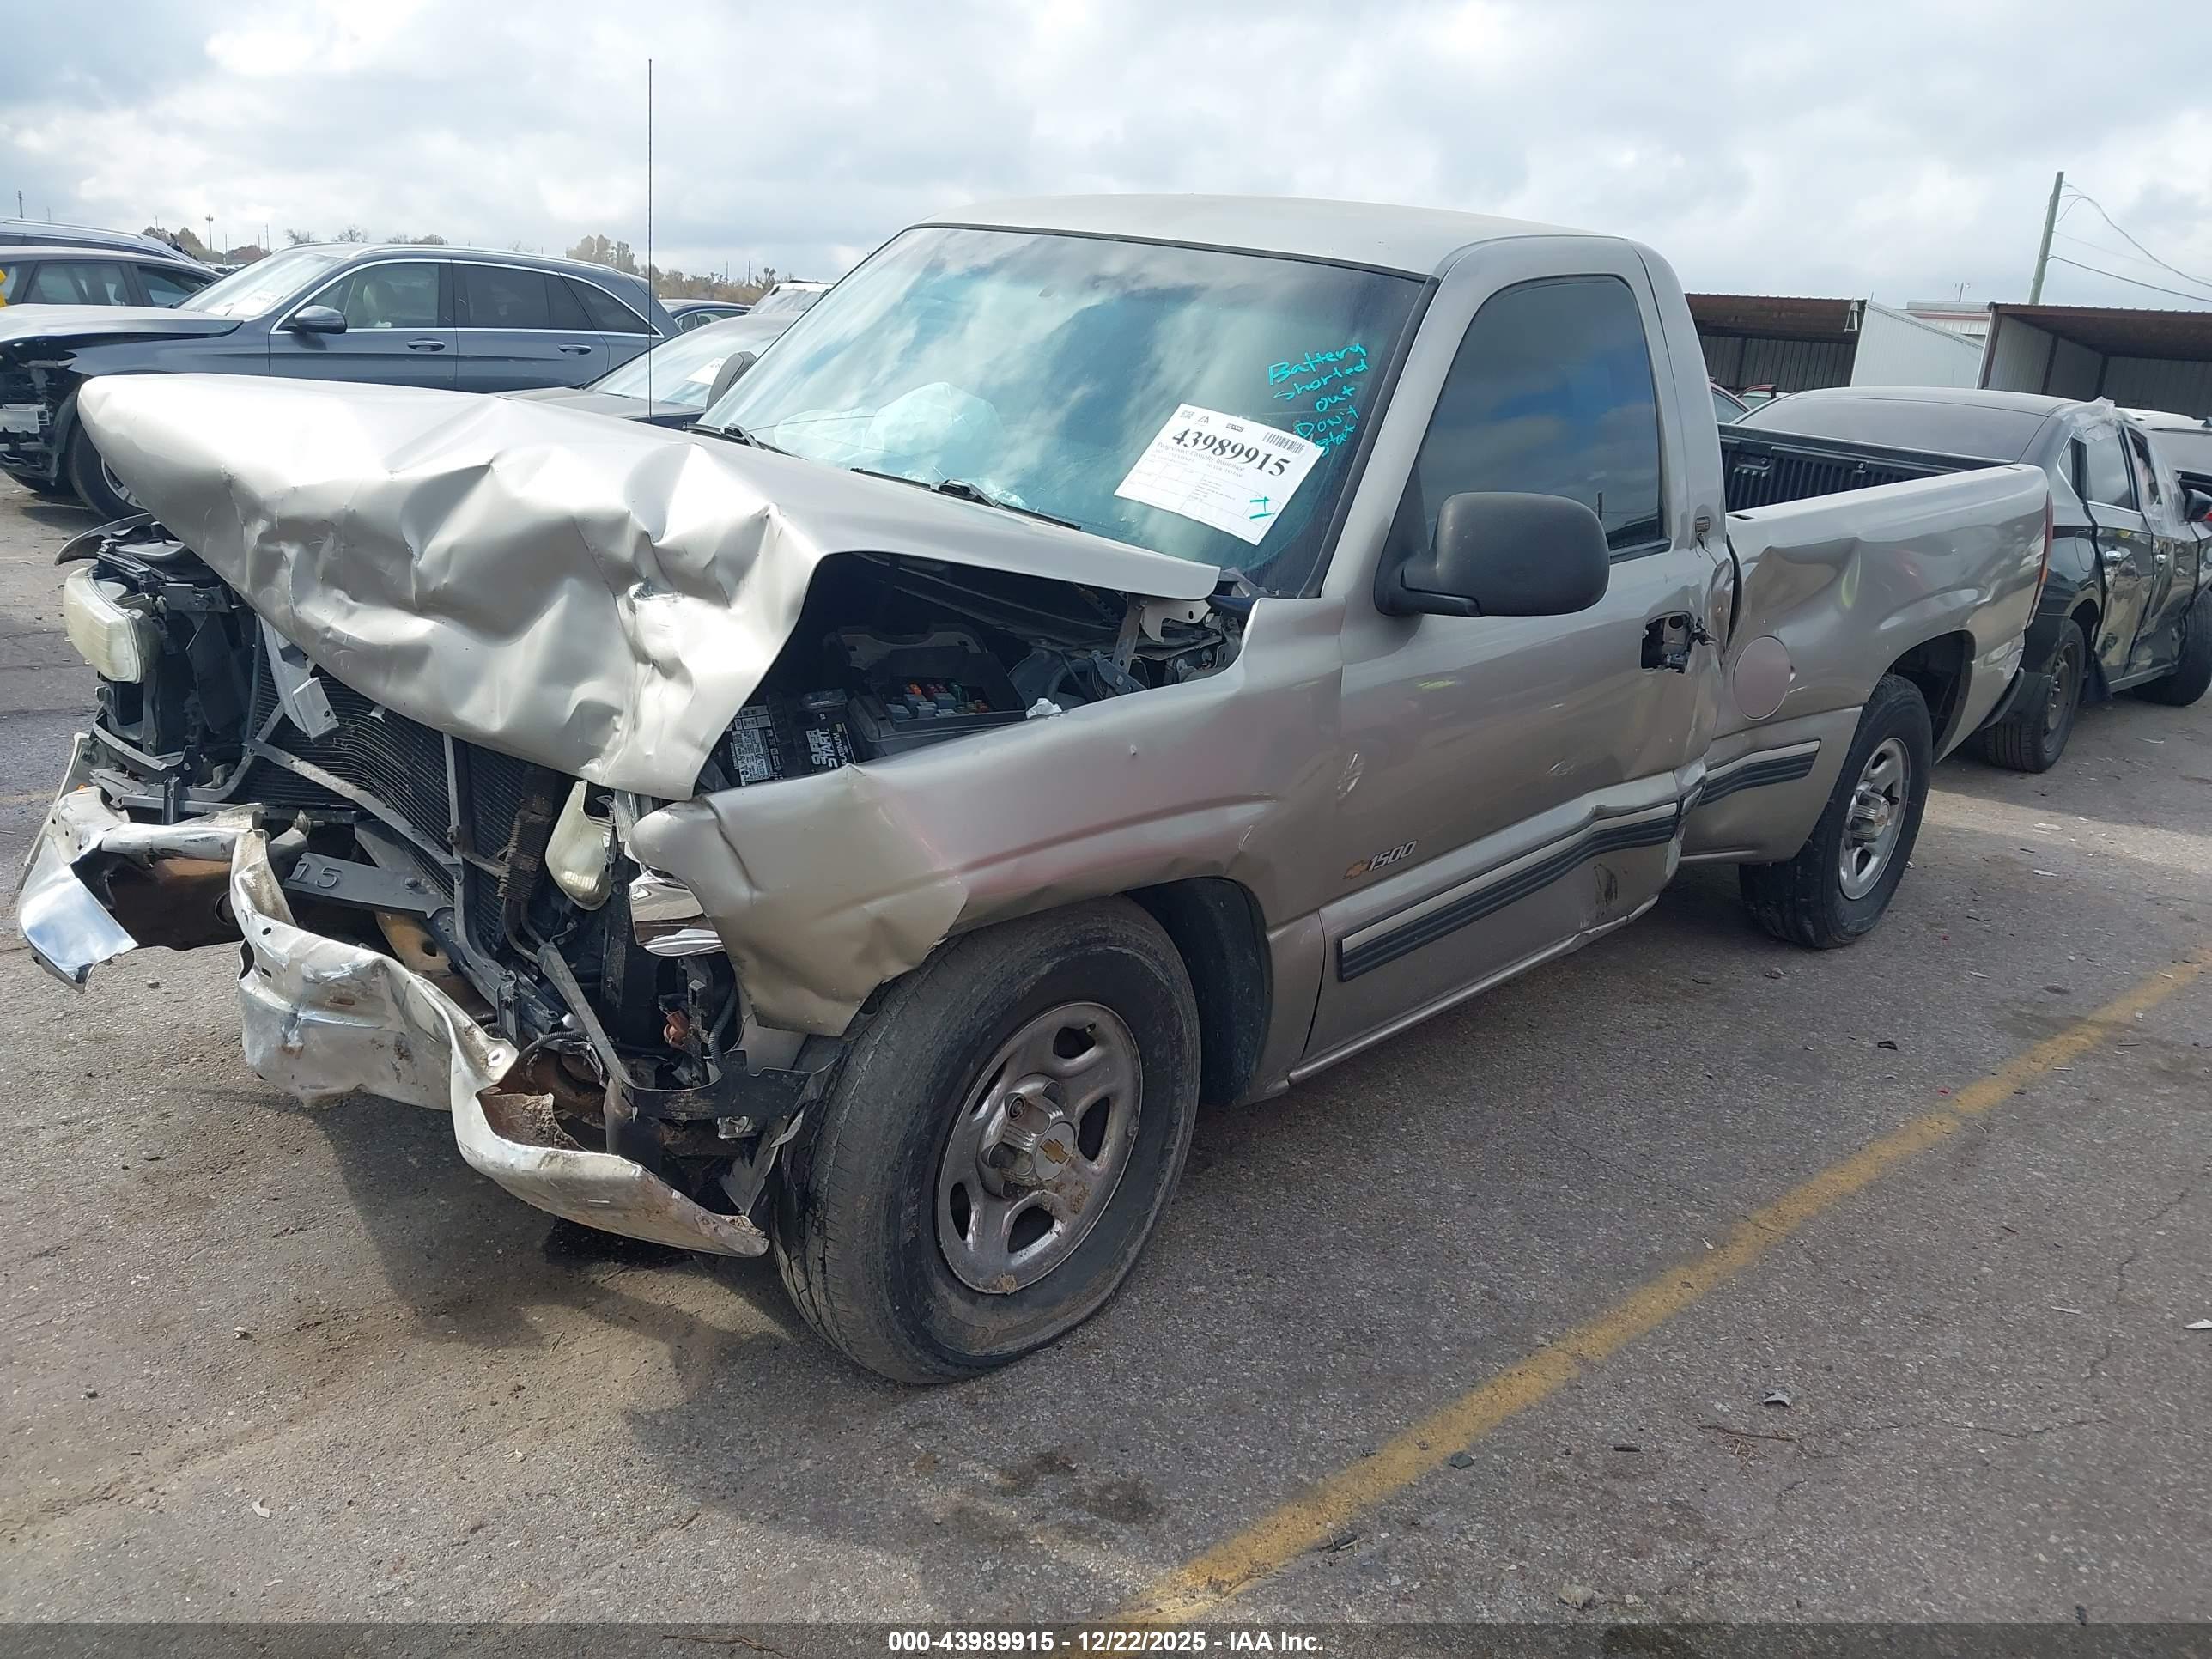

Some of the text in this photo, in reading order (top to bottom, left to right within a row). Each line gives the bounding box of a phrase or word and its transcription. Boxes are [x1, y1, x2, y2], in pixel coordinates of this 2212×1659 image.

[1268, 343, 1367, 386] Battery
[1316, 385, 1355, 412] out
[1171, 428, 1291, 477] 43989915
[806, 729, 828, 765] SUPER
[817, 728, 838, 768] START
[1368, 840, 1417, 872] 1500
